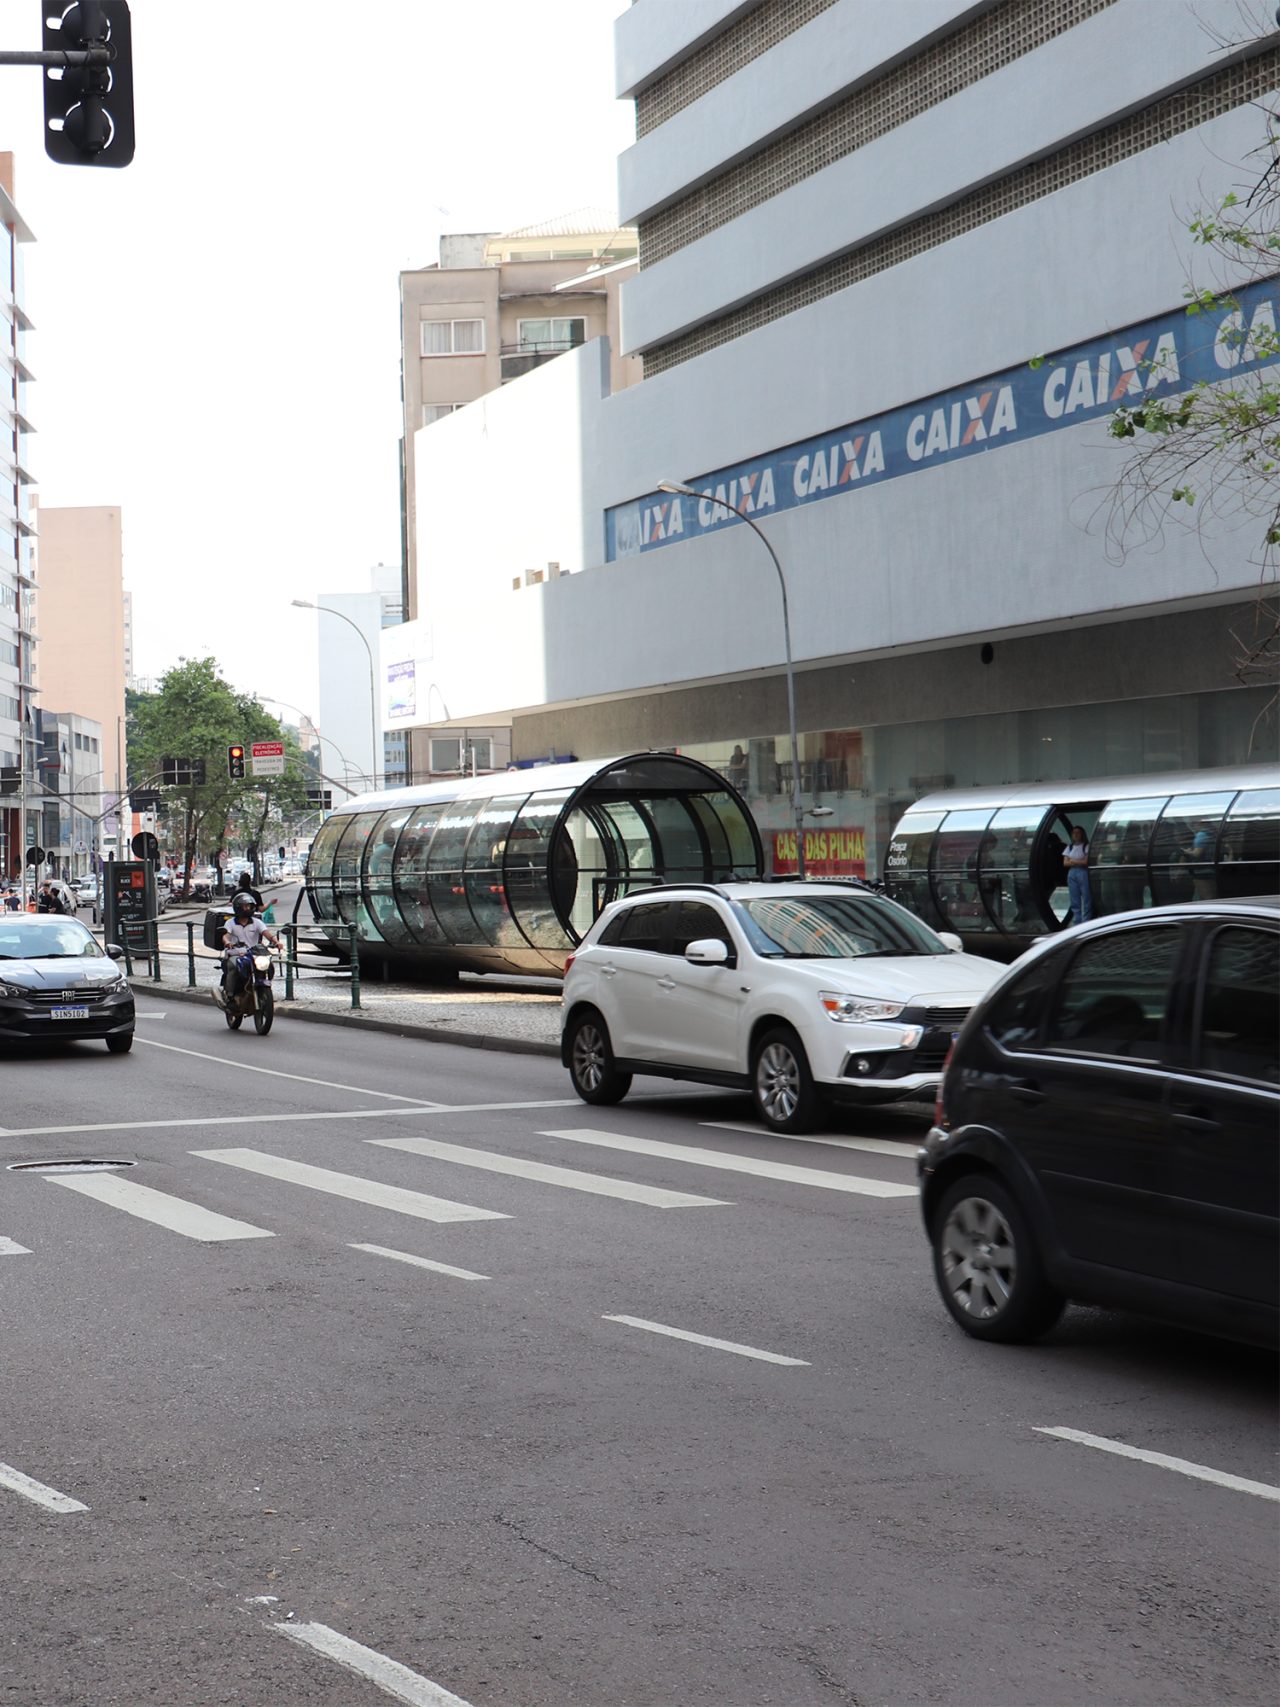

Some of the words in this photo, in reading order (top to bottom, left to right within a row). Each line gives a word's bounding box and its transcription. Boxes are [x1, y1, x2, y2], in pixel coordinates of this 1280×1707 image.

[1043, 332, 1181, 418] CAIXA
[906, 386, 1017, 461] CAIXA
[793, 430, 885, 498] CAIXA
[698, 468, 776, 527] CAIXA
[777, 832, 799, 860] CAS
[805, 832, 827, 860] DAS
[887, 855, 907, 866] Osório
[890, 842, 907, 854] Praça
